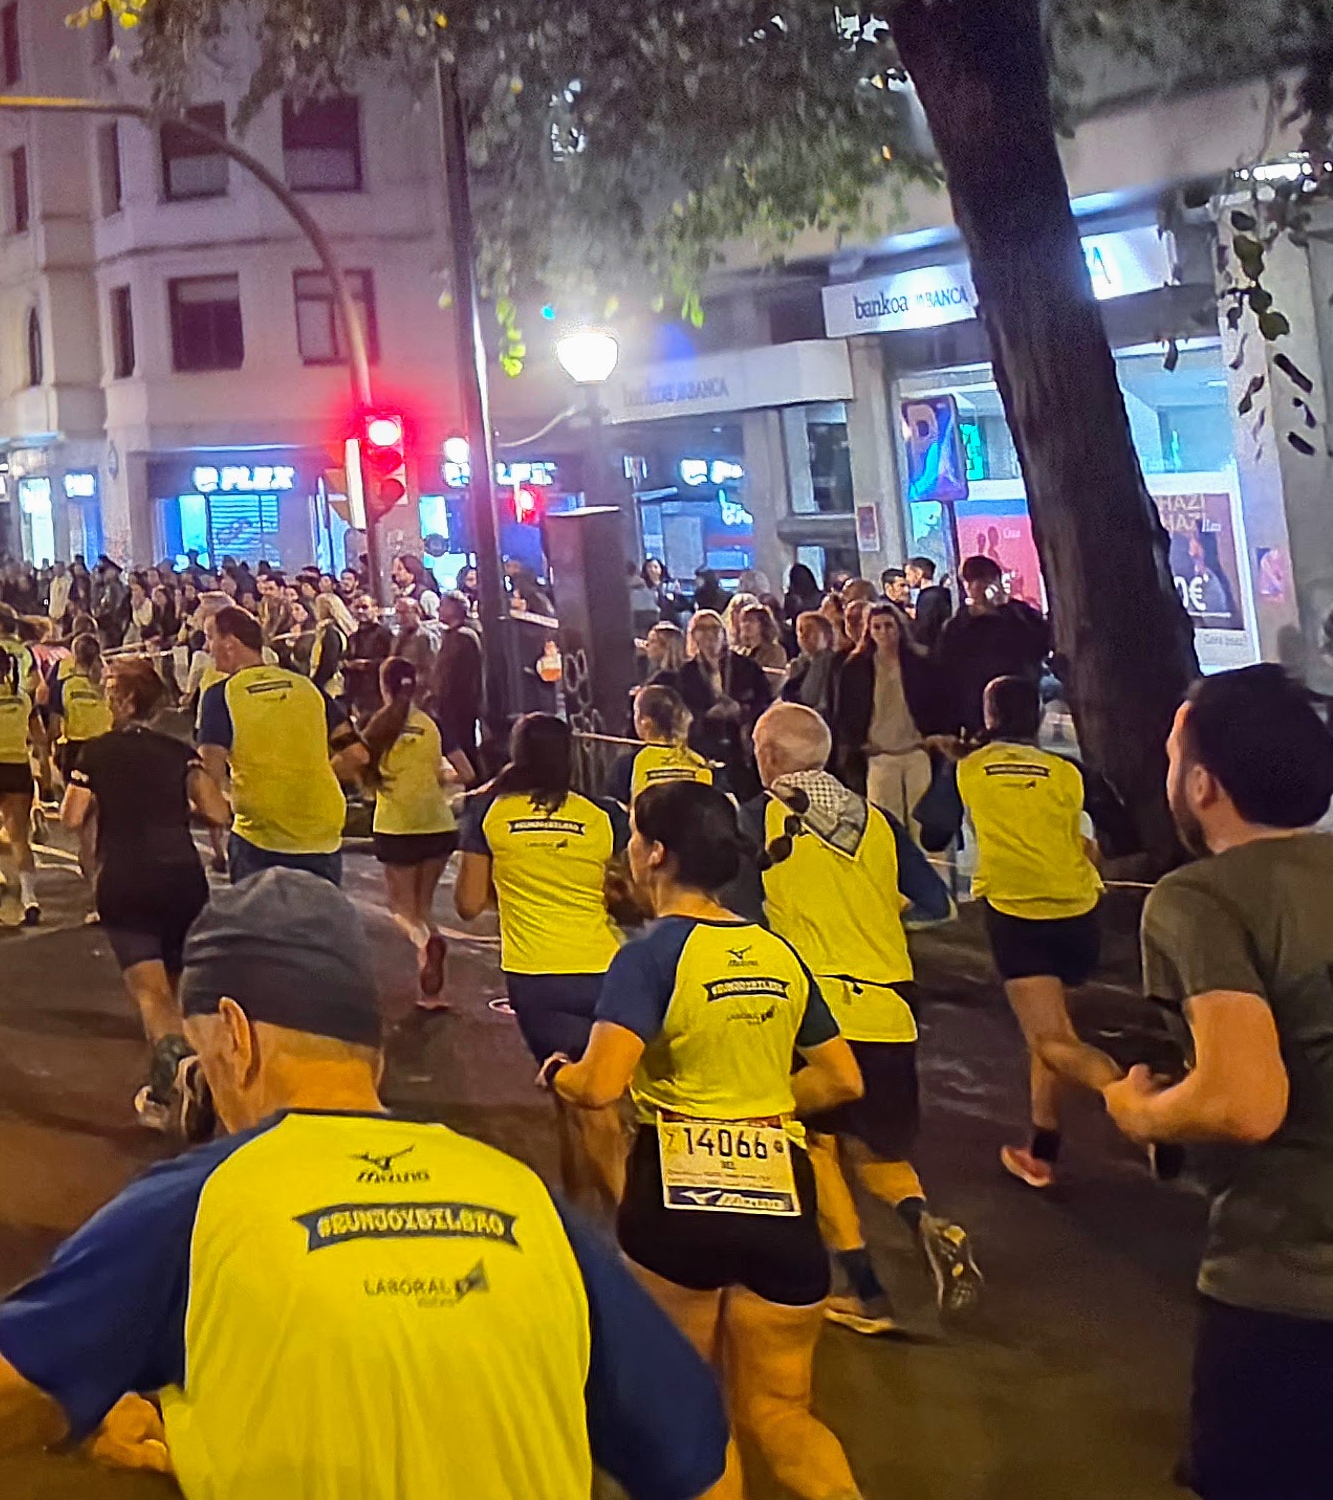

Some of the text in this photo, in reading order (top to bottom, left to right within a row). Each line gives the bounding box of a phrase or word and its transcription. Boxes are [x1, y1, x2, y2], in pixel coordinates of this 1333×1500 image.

[853, 292, 908, 320] bankoa
[684, 1126, 768, 1159] 14066
[363, 1278, 453, 1296] LABORAL
